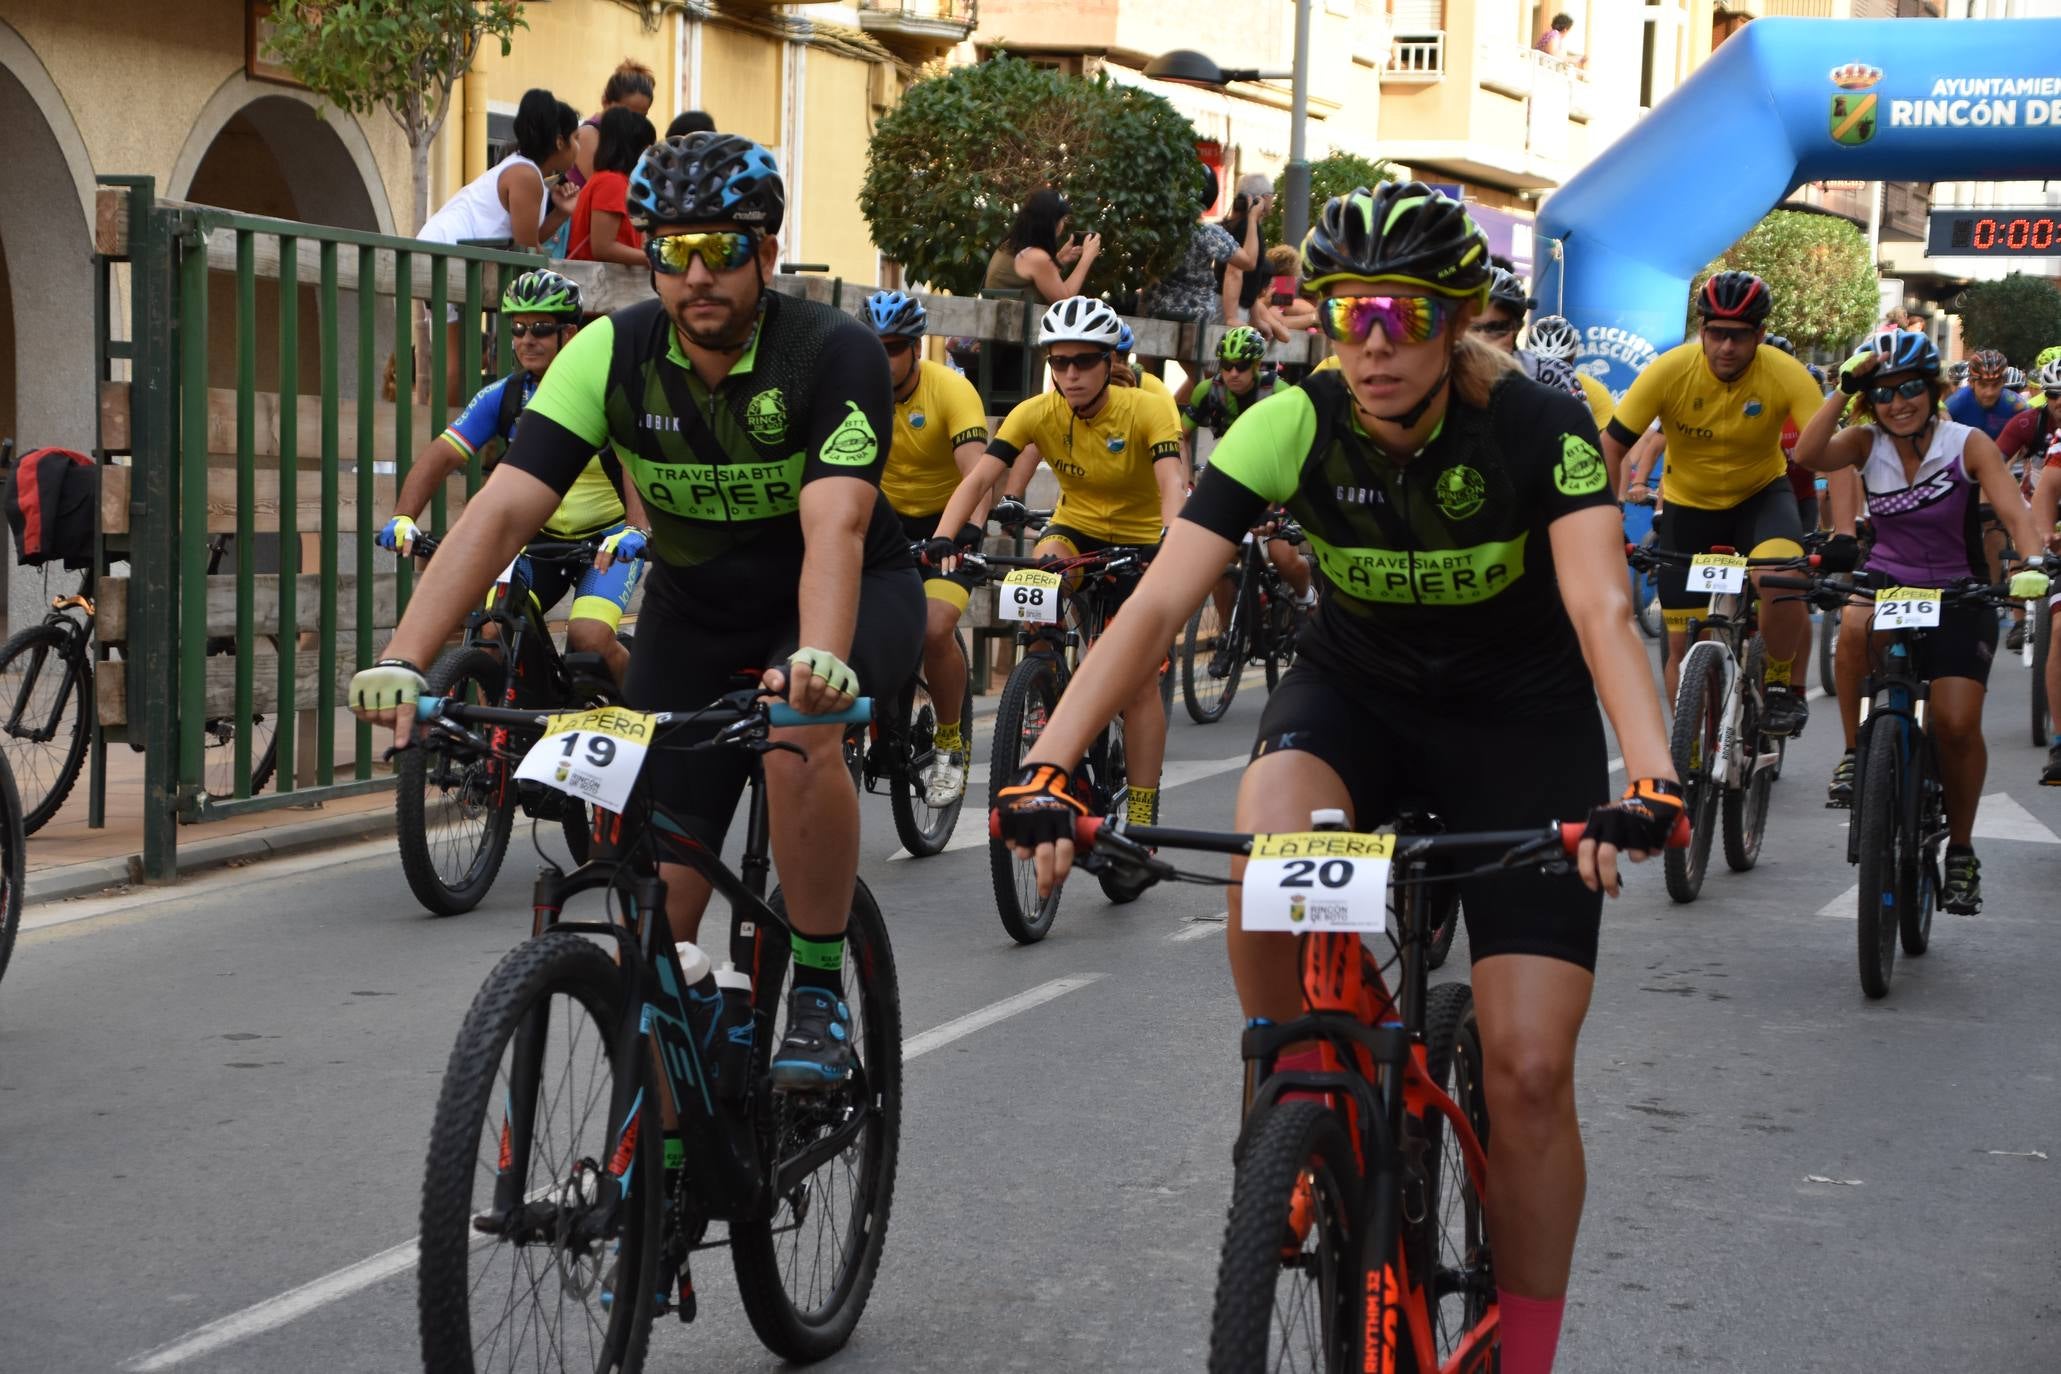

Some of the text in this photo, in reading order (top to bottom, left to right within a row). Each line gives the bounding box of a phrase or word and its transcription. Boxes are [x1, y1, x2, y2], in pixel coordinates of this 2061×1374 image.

[1891, 100, 2016, 126] RINCÓN
[638, 413, 680, 431] OBIK
[845, 420, 865, 428] BTT
[1676, 421, 1713, 440] Virto
[653, 465, 785, 482] TRAVESIA BTT
[1352, 553, 1473, 569] TRAVESIA BTT
[1007, 574, 1057, 585] LA PERA
[1385, 563, 1508, 593] PERA
[1702, 567, 1729, 580] 61
[1013, 587, 1044, 606] 68
[1882, 600, 1934, 616] 216
[583, 713, 647, 738] PERA
[560, 732, 617, 768] 19
[1260, 840, 1385, 856] LA PERA
[1279, 860, 1354, 888] 20
[1363, 1269, 1380, 1373] RHYTHM 32
